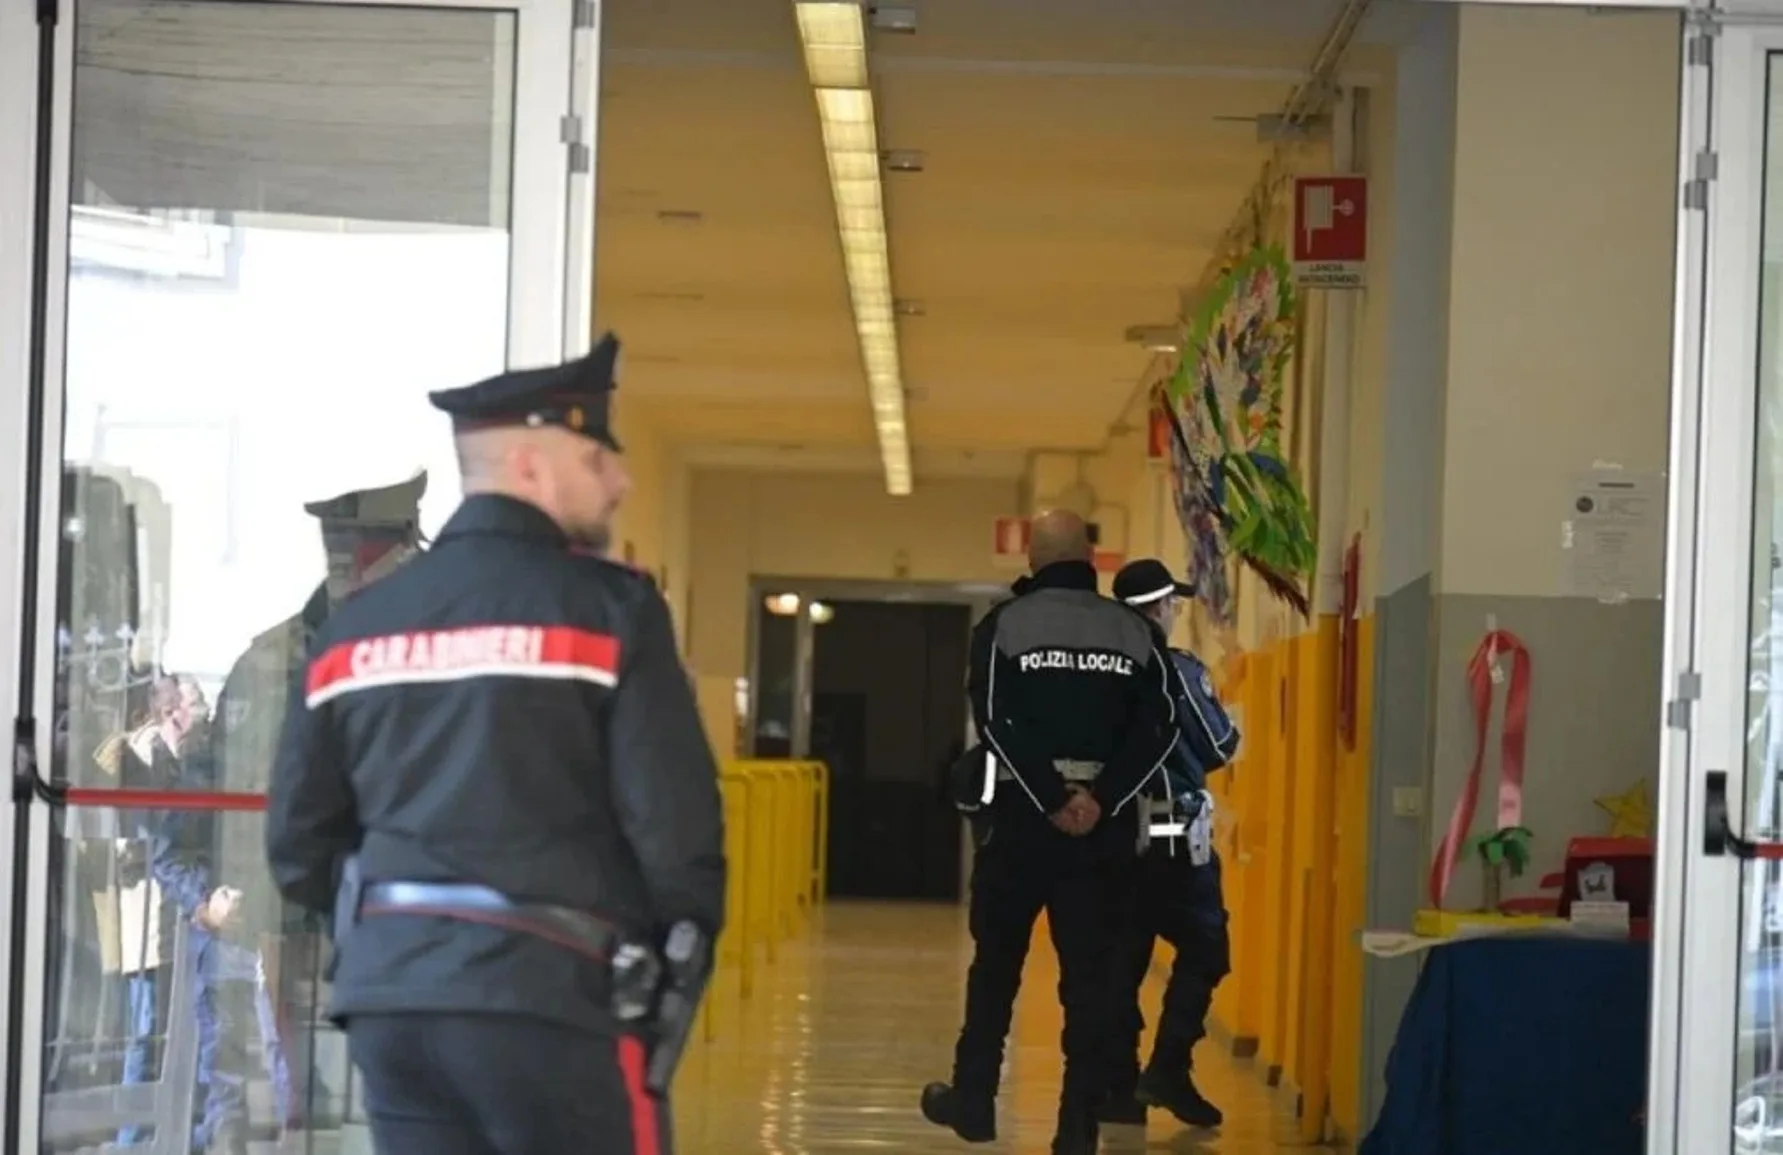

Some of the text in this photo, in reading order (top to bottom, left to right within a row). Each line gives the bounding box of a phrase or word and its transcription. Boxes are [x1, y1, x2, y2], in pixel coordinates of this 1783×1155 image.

[351, 625, 543, 677] CARABINIERI
[1020, 650, 1133, 676] POLIZIA LOCALE
